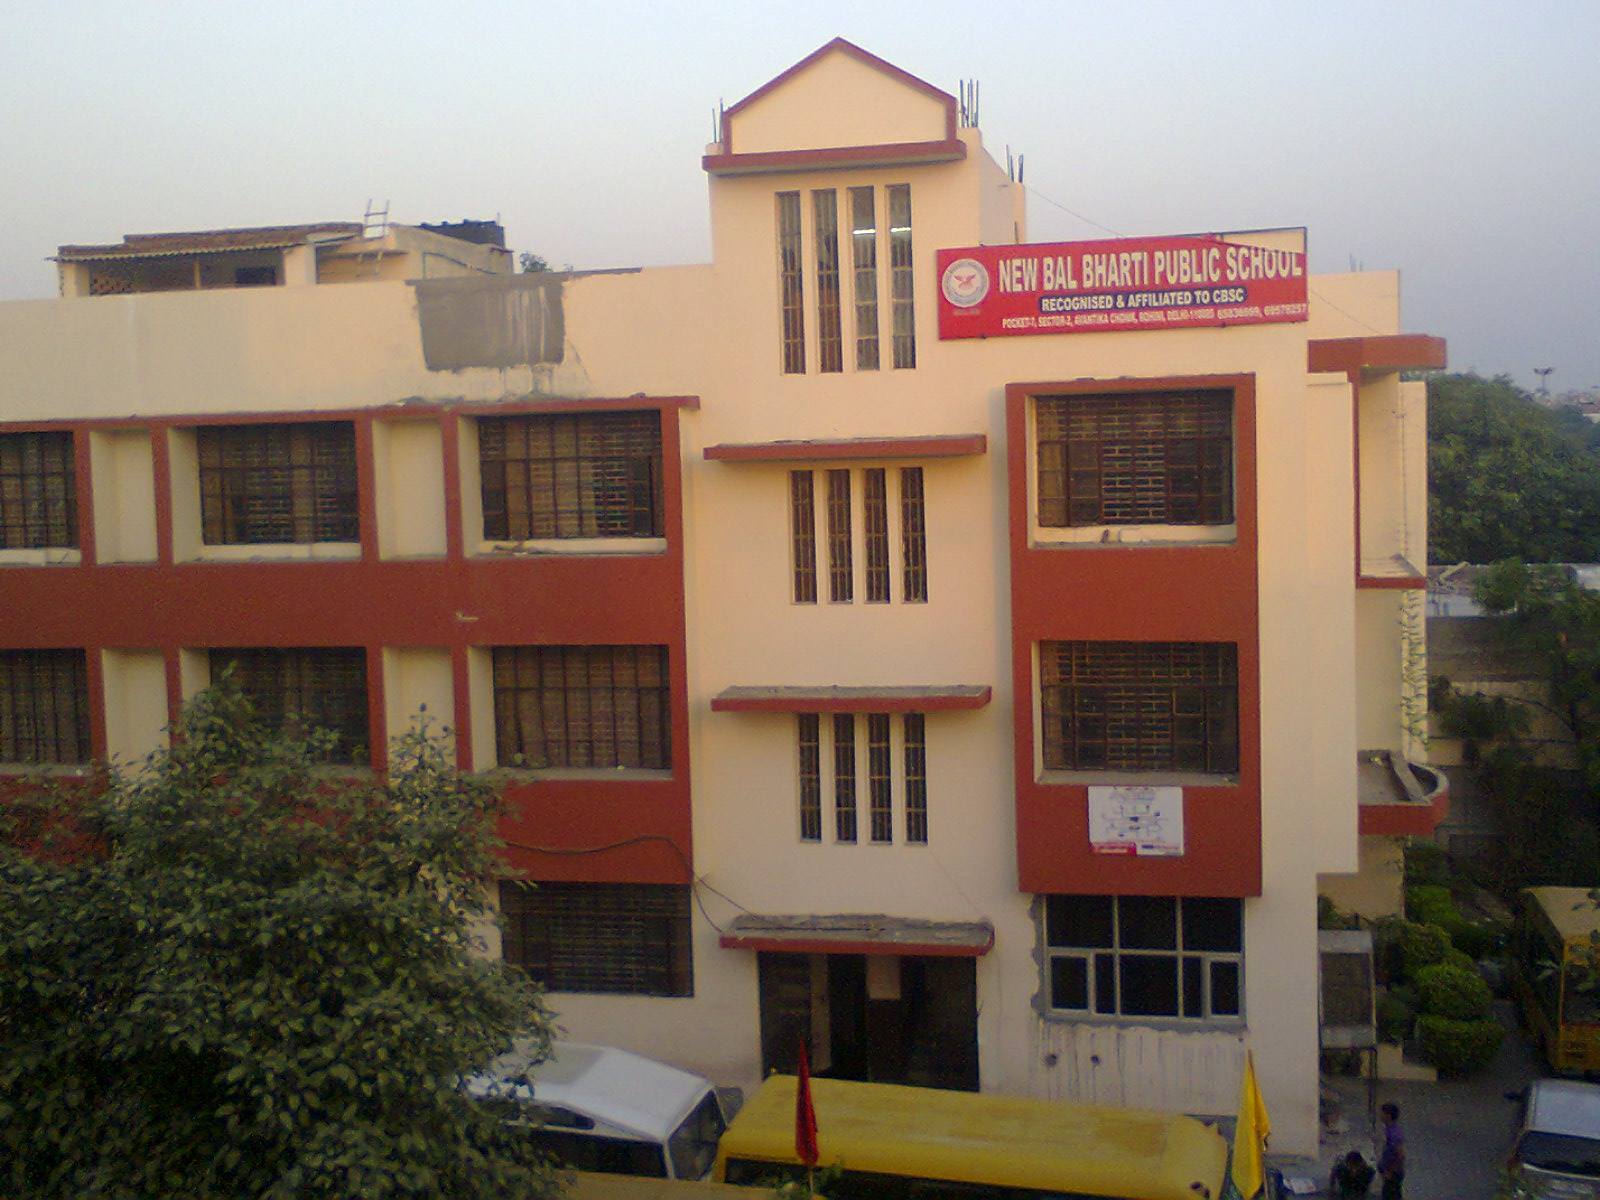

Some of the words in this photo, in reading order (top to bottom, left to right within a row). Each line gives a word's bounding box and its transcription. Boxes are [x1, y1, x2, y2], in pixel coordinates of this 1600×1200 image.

[999, 258, 1038, 292] NEW
[1043, 256, 1078, 290] BAL
[1082, 252, 1149, 288] BHARTI
[1154, 248, 1220, 284] PUBLIC
[1226, 247, 1303, 281] SCHOOL
[1042, 295, 1113, 312] RECOGNISED
[1116, 295, 1125, 308] &
[1128, 291, 1191, 308] AFFILIATED
[1194, 290, 1210, 305] TO
